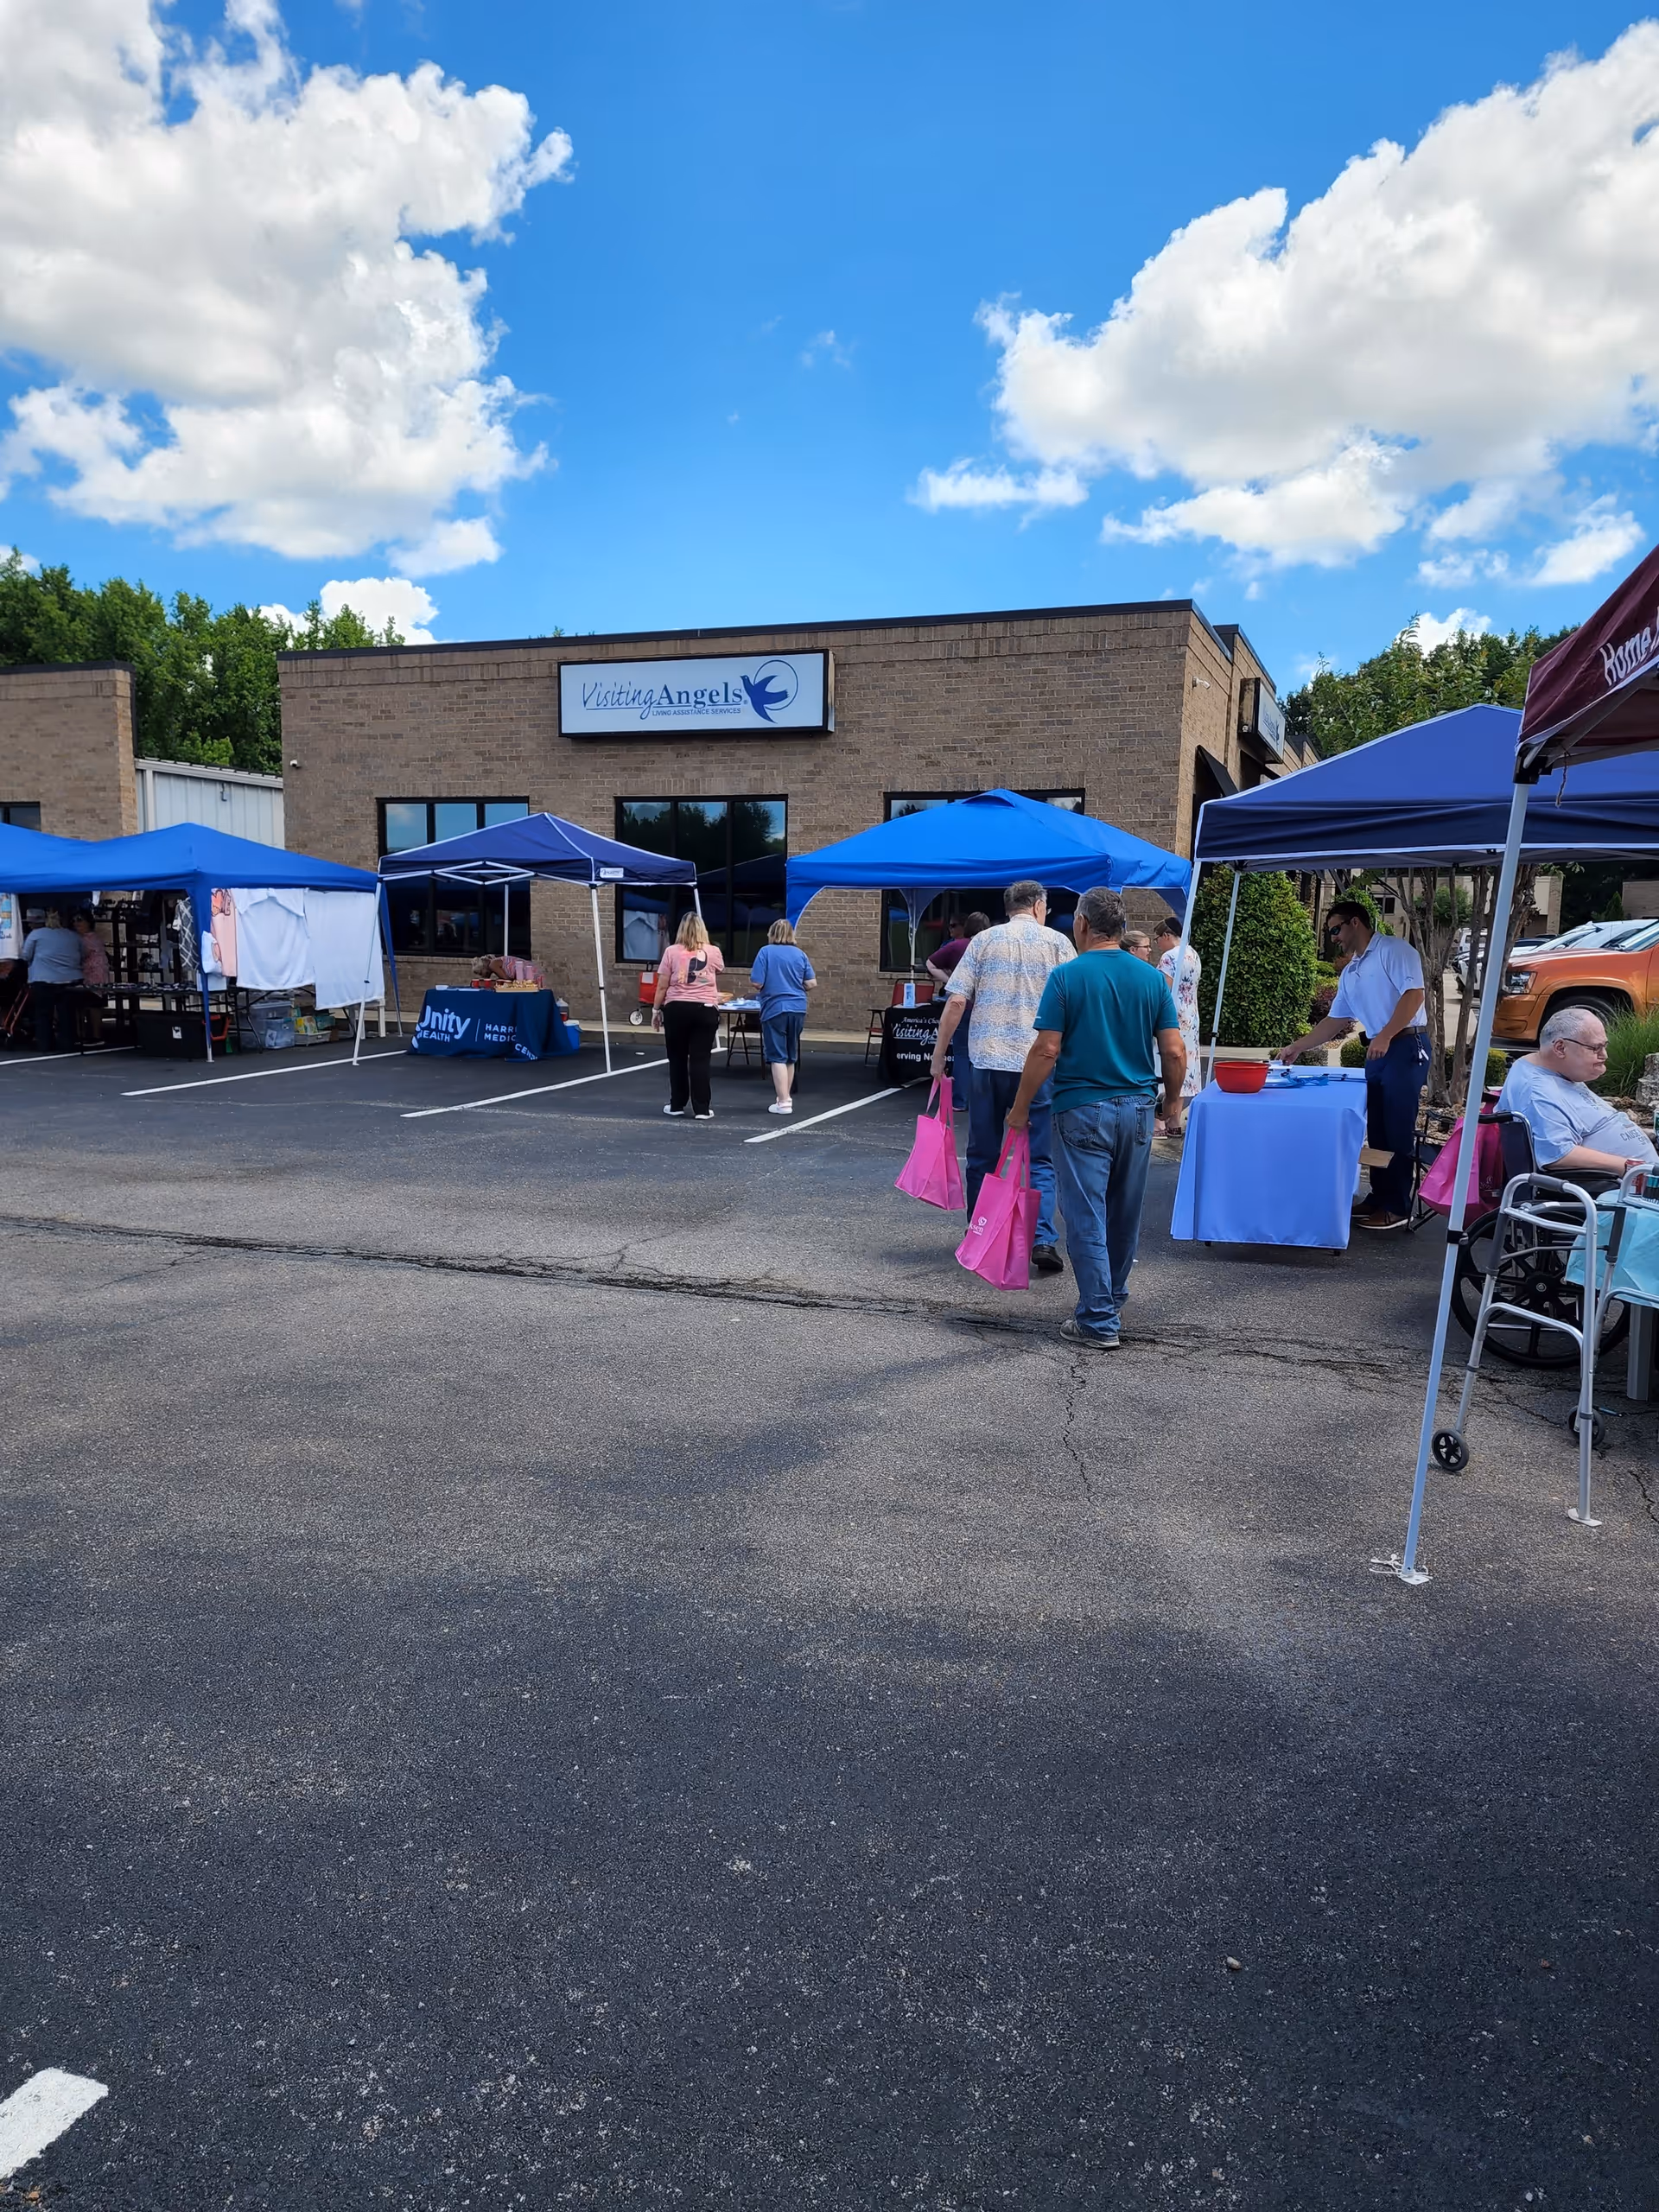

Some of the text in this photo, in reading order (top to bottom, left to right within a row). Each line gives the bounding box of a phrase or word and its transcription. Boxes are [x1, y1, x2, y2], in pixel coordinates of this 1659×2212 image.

[1599, 626, 1651, 686] Home
[582, 681, 743, 721] Visiting Angels
[484, 1033, 517, 1042] MEDIC
[896, 1052, 921, 1062] erving
